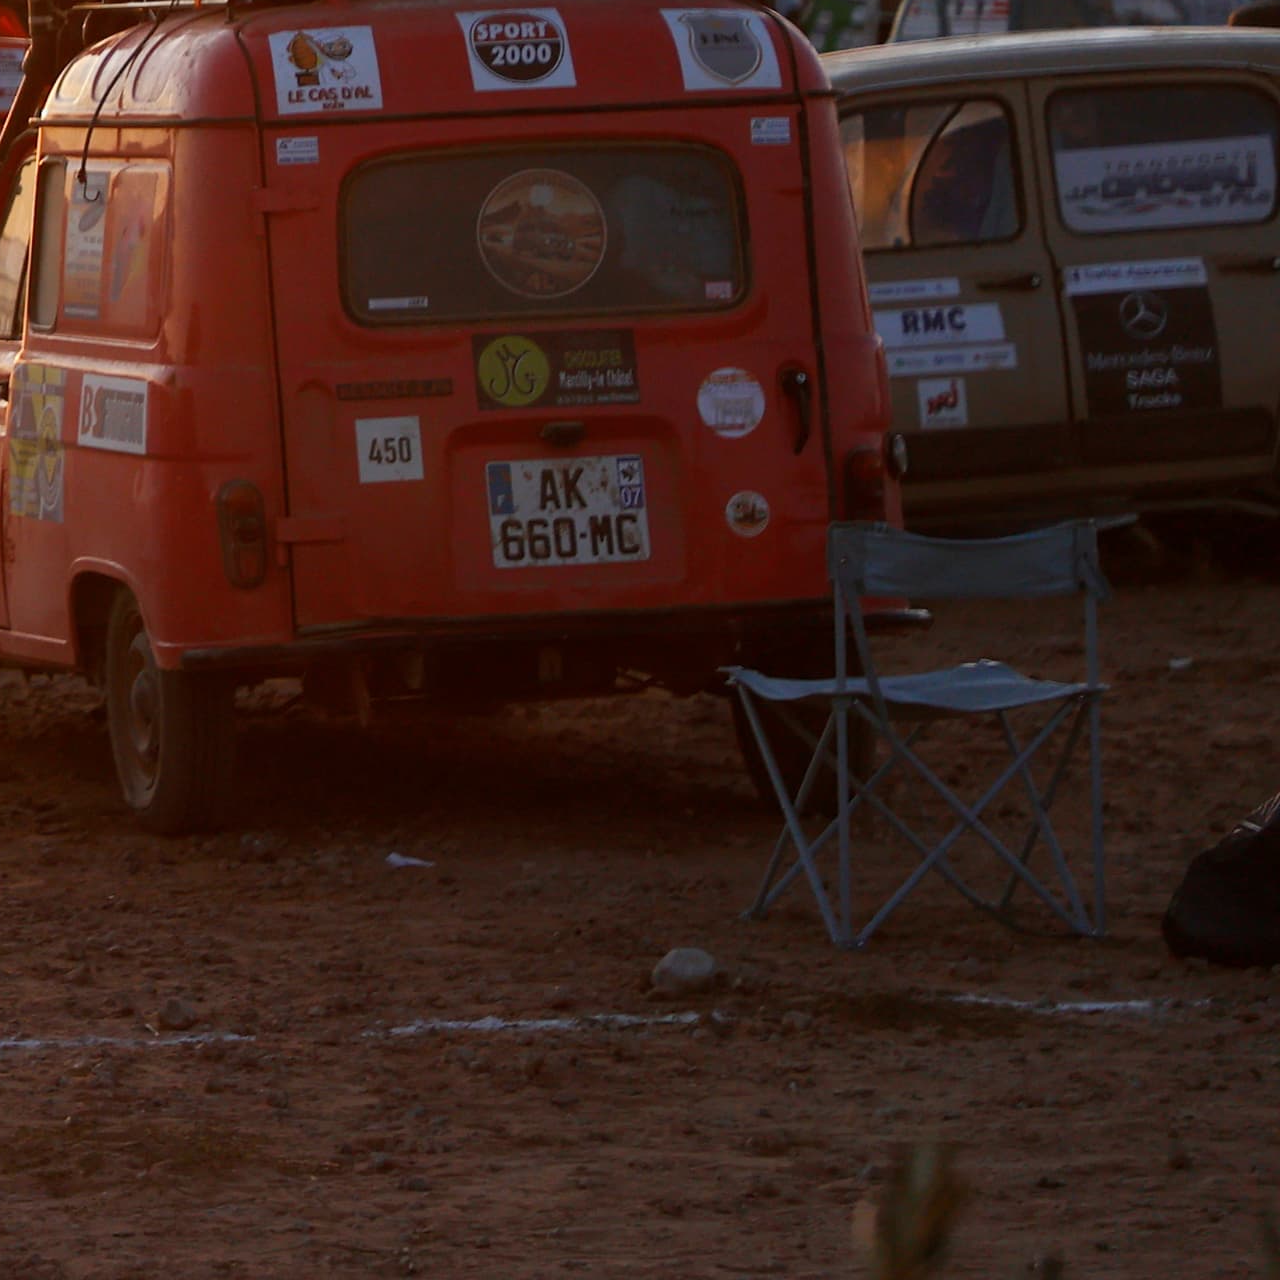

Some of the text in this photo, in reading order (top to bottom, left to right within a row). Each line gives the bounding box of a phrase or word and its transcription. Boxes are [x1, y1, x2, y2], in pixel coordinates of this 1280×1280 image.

[476, 20, 549, 42] SPORT
[491, 43, 552, 66] 2000
[288, 90, 306, 104] LE
[308, 87, 338, 102] CAS
[900, 306, 967, 335] RMC
[1126, 367, 1179, 390] SAGA
[368, 436, 413, 465] 450
[540, 468, 589, 511] AK
[620, 485, 642, 508] 07
[500, 513, 643, 563] 660-MC
